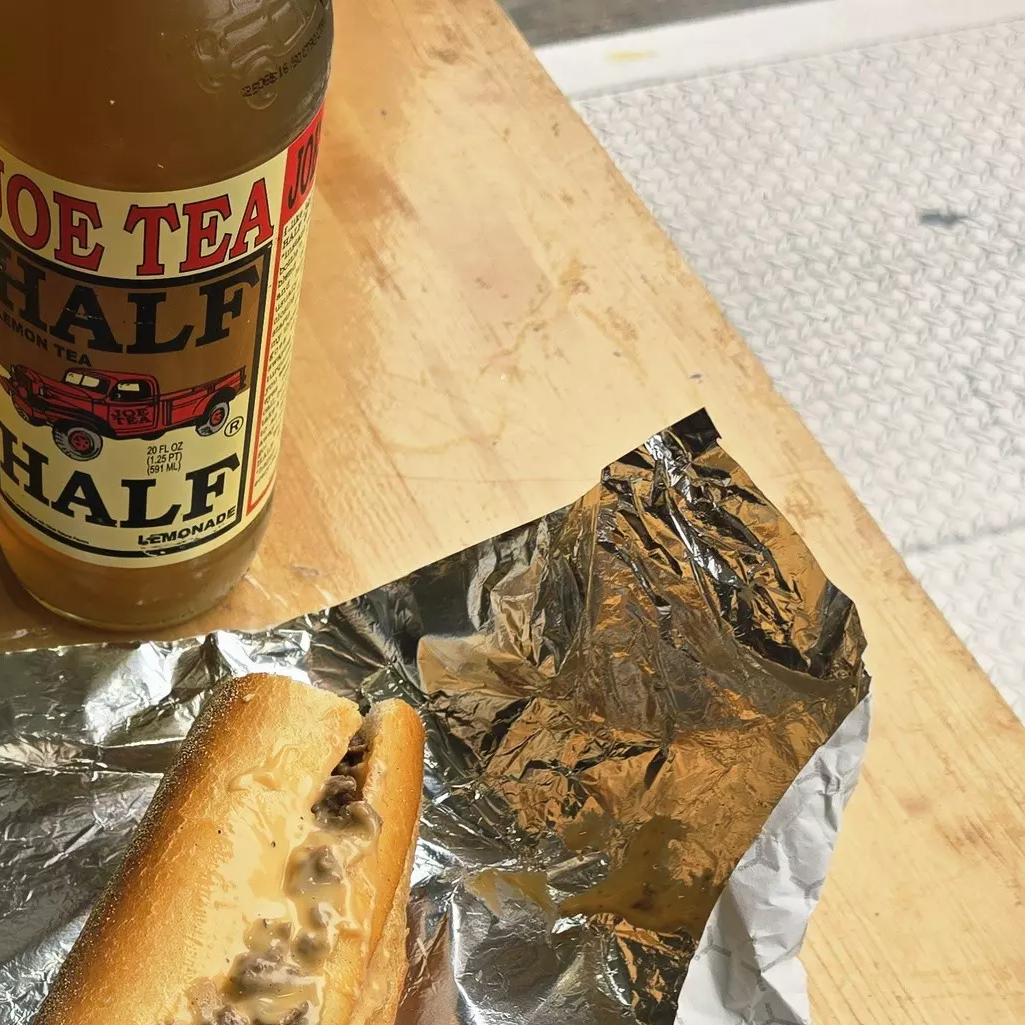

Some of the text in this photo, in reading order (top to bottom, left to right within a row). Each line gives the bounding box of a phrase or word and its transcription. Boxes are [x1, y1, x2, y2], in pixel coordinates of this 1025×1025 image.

[123, 177, 275, 277] TEA
[53, 342, 92, 368] TEA
[111, 408, 149, 418] JOE
[115, 415, 153, 425] TEA
[147, 442, 183, 455] 20 FL OZ
[146, 451, 183, 466] (1.25 PT)
[146, 461, 182, 476] (591 ML)
[138, 505, 236, 546] LEMONADE
